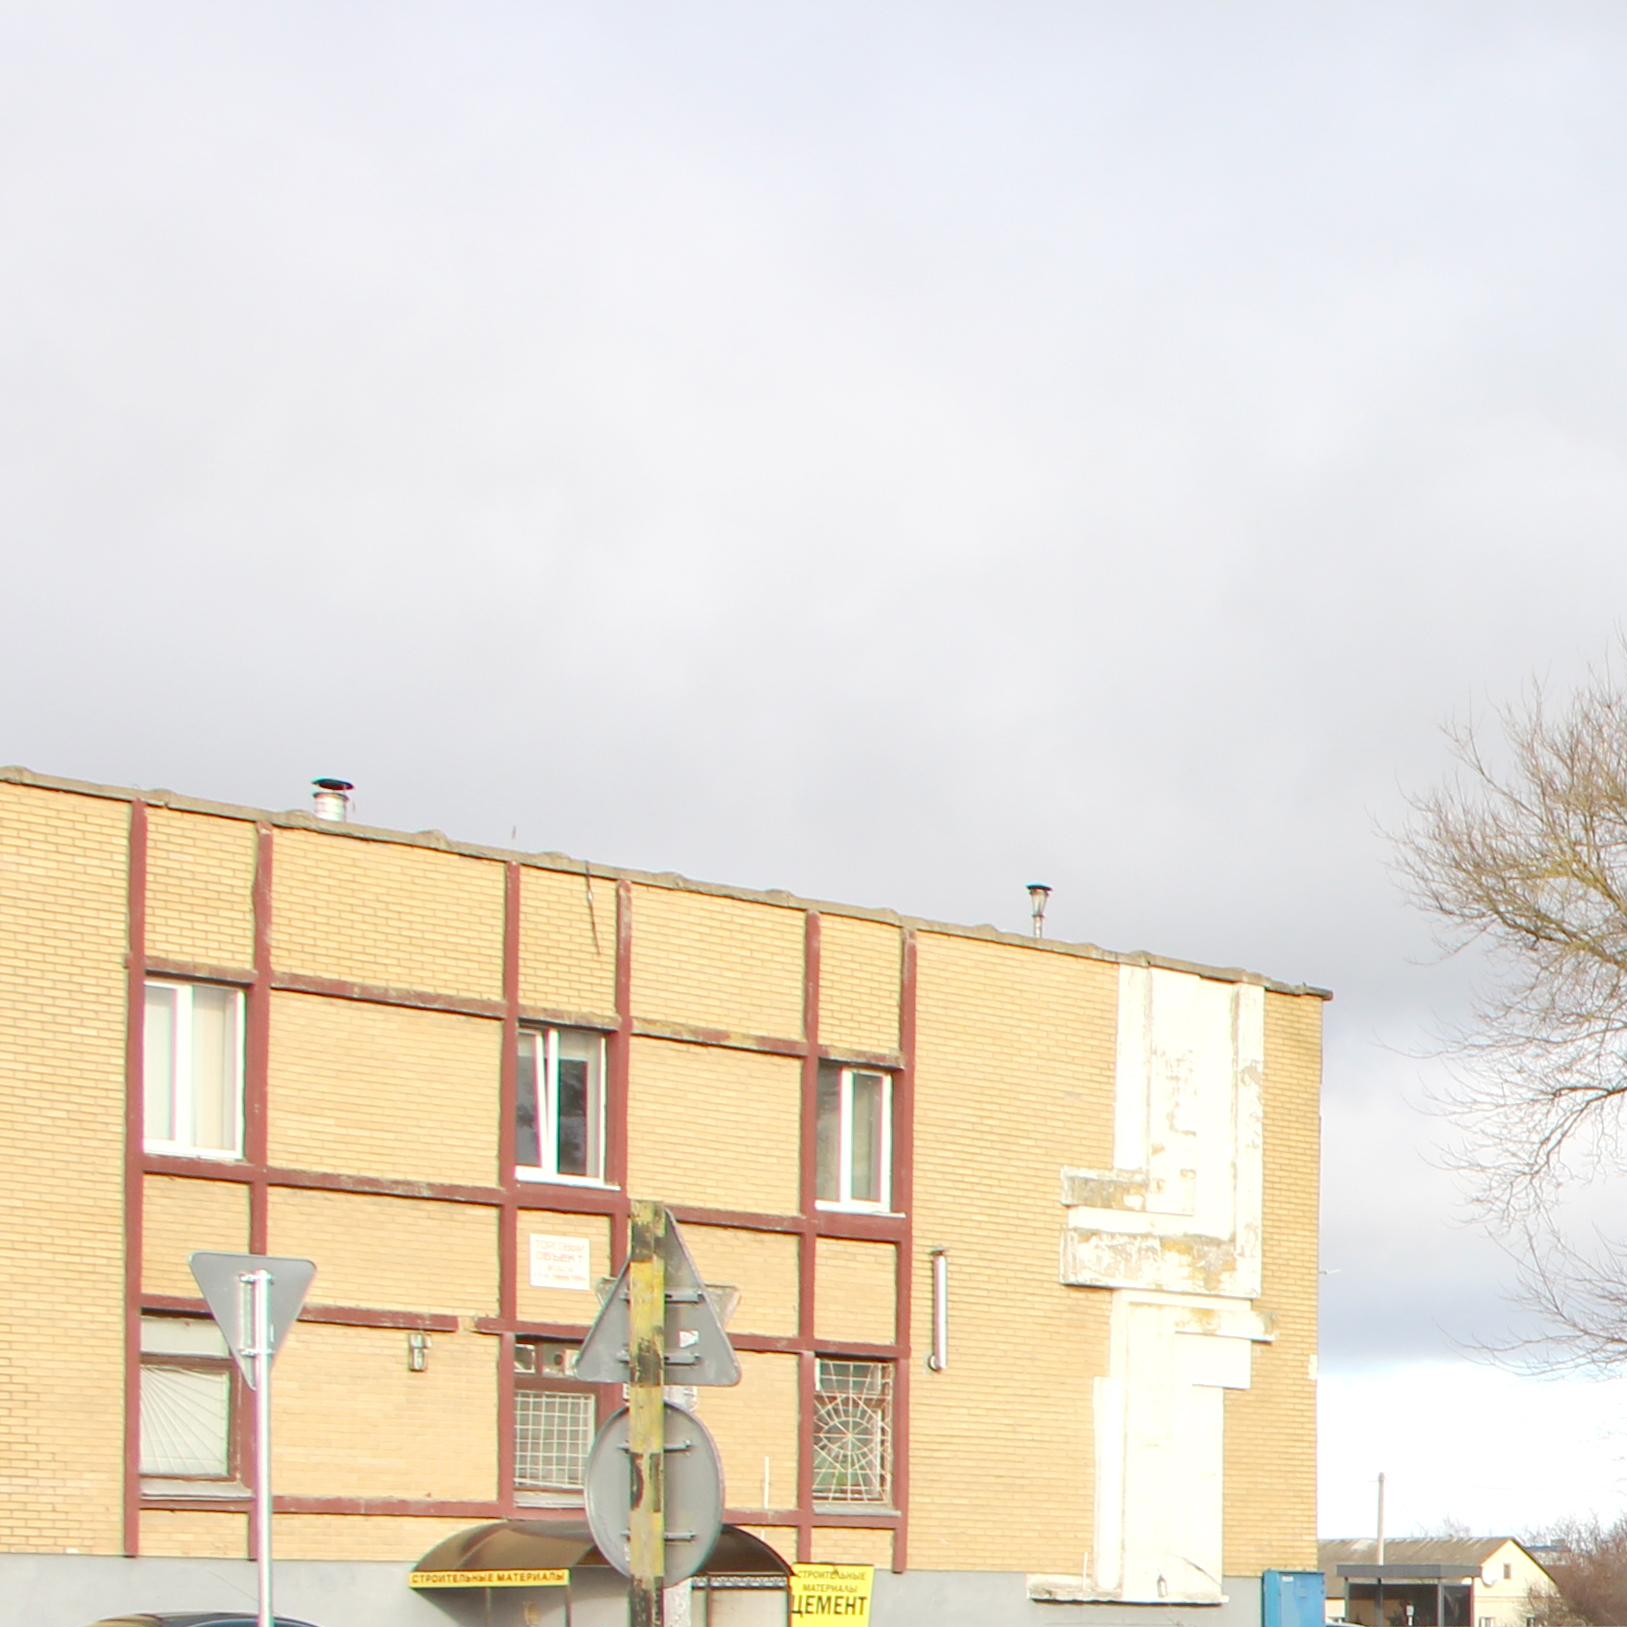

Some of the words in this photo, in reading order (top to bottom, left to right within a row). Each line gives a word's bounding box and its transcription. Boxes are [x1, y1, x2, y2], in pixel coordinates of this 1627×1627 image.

[412, 1574, 494, 1583] СТРОИТЕЛЬНЫЕ
[497, 1572, 565, 1582] МАТЕРИАЛЫ
[803, 1584, 858, 1593] МАТЕРИАЛЫ
[792, 1595, 868, 1618] ЦЕМЕНТ
